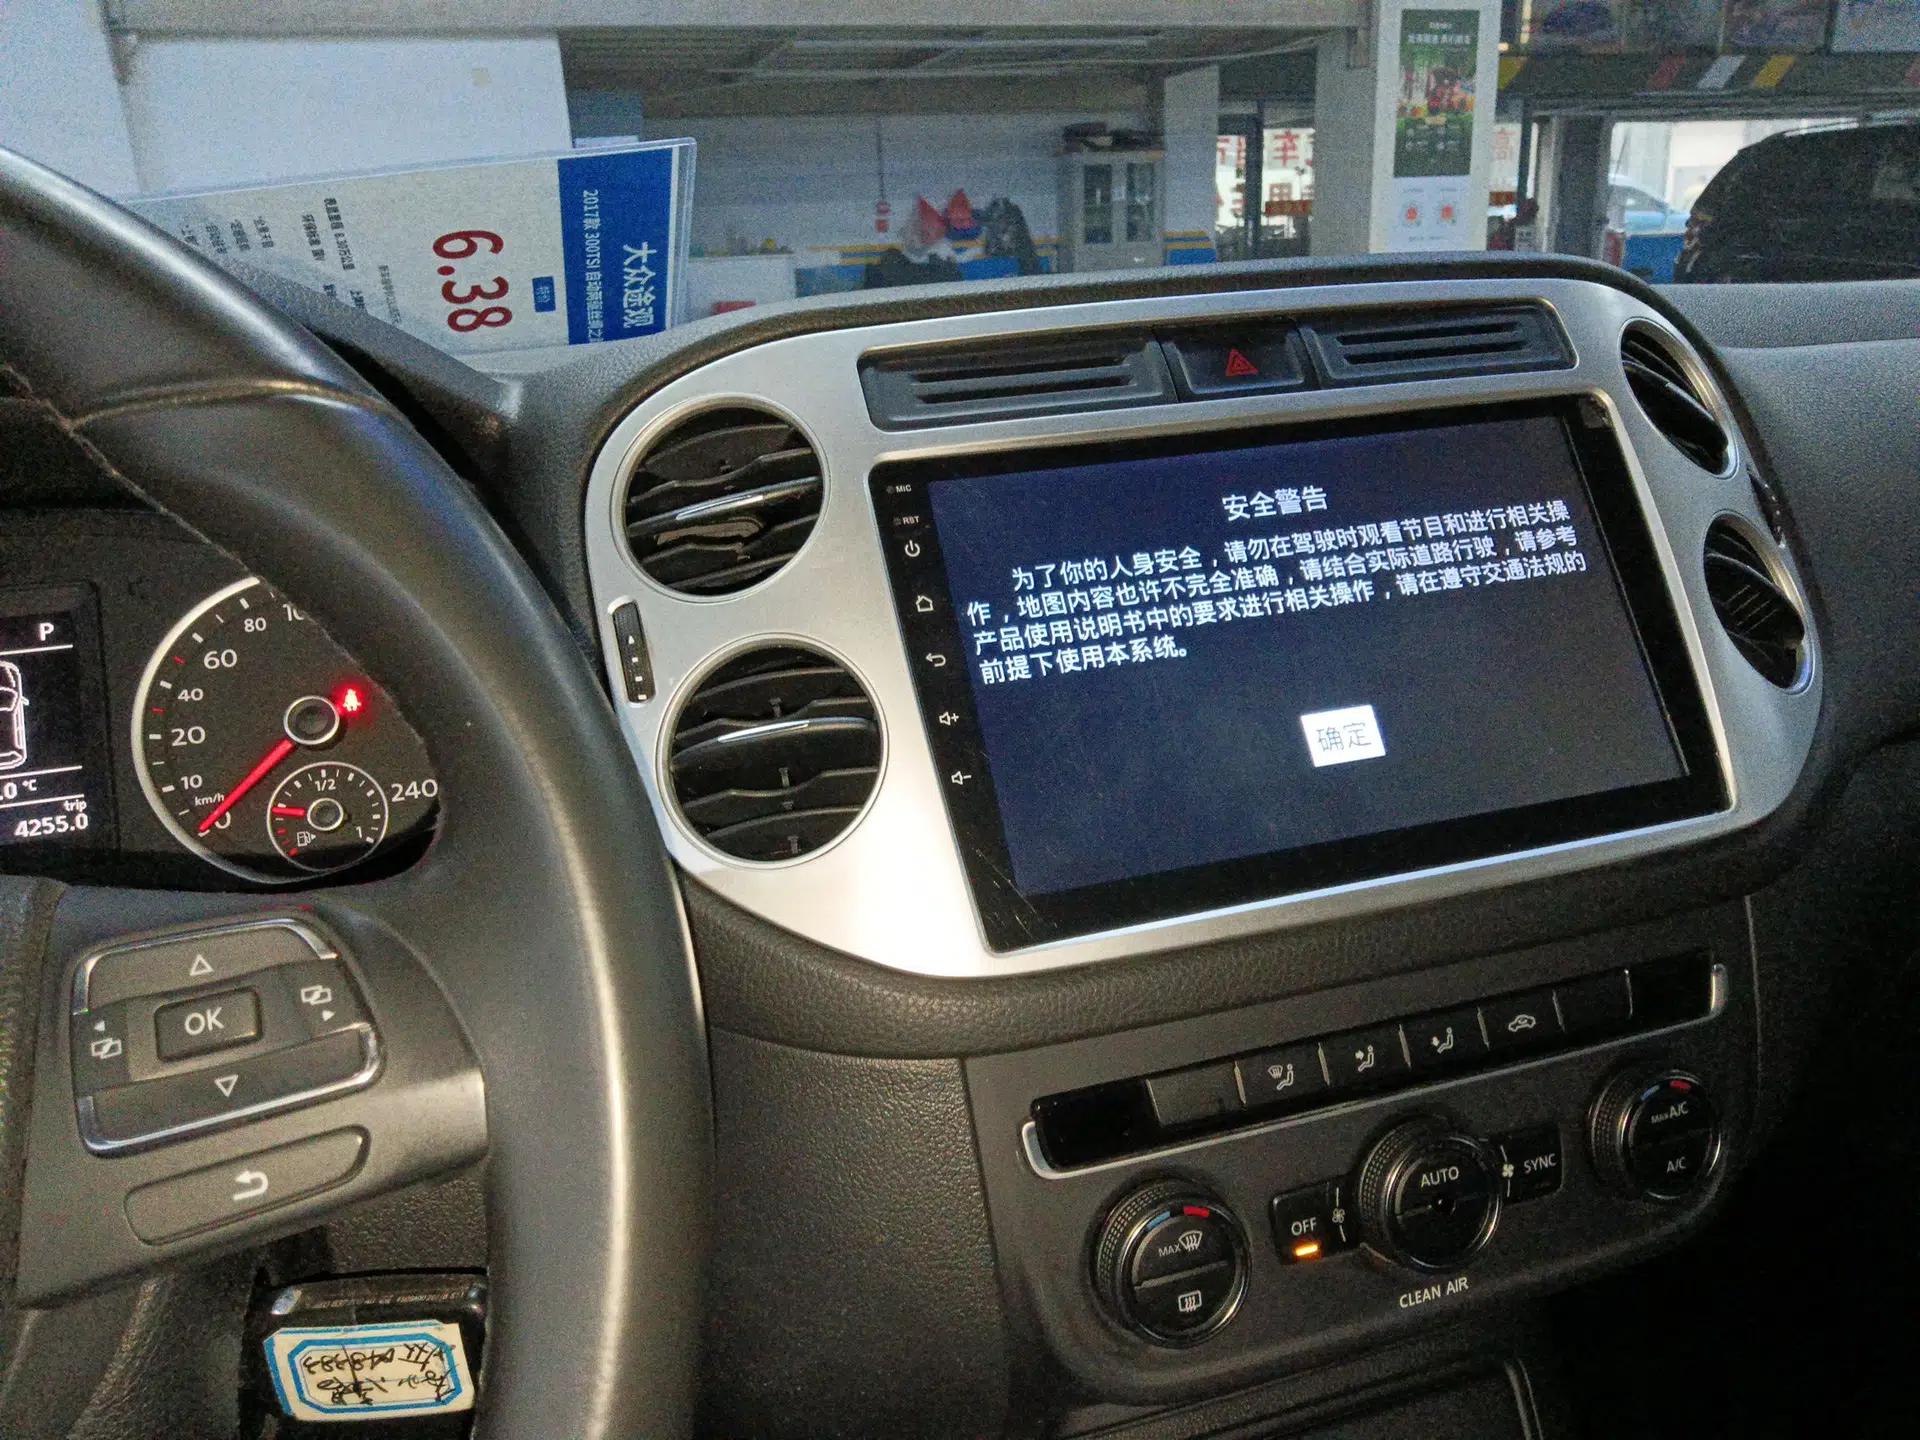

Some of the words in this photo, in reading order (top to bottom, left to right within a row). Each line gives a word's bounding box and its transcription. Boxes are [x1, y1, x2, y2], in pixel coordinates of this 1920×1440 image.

[583, 189, 600, 230] 2017款
[585, 232, 600, 269] 300TSI
[433, 230, 512, 332] 6.38
[623, 242, 656, 328] 大众途观
[895, 484, 912, 493] MIC
[1222, 487, 1327, 521] 安全警告
[902, 515, 919, 525] RST
[39, 622, 55, 641] P
[244, 617, 267, 632] 80
[203, 650, 238, 670] 60
[980, 634, 1189, 685] 前提下使用本系统。
[178, 688, 204, 702] 40
[171, 726, 206, 746] 20
[1316, 722, 1373, 754] 确定
[180, 774, 203, 790] 10
[315, 778, 337, 791] 1/2
[391, 779, 439, 802] 240
[63, 799, 87, 812] trip
[194, 792, 225, 806] km/h
[14, 812, 89, 837] 4255.0
[356, 826, 363, 838] 1
[185, 1007, 225, 1036] OK
[1670, 1101, 1689, 1119] A/C
[1524, 1153, 1558, 1174] SYNC
[1666, 1156, 1686, 1173] A/C
[1420, 1165, 1460, 1188] AUTO
[1291, 1217, 1318, 1236] OFF
[1158, 1242, 1181, 1257] MAX
[1399, 1284, 1442, 1309] CLEAN
[1446, 1277, 1469, 1296] AIR
